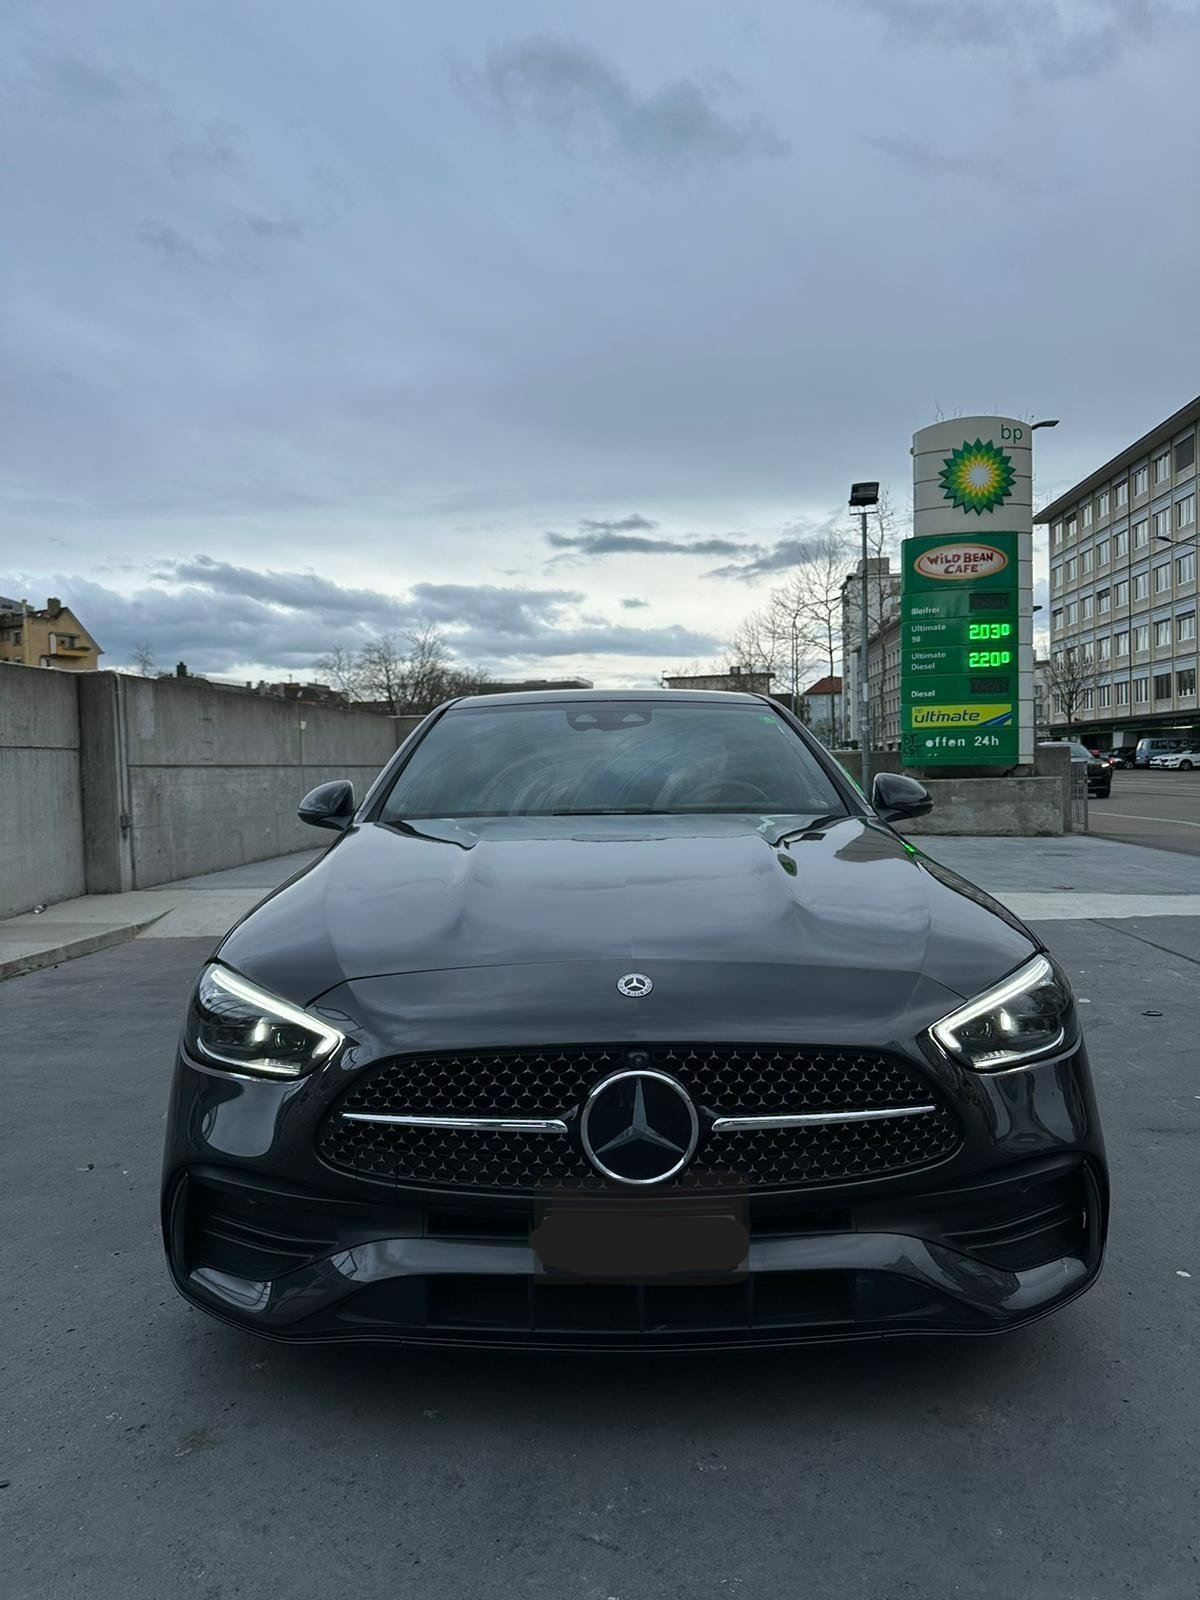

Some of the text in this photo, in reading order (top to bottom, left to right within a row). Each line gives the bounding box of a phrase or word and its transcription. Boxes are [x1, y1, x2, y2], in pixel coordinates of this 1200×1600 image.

[1001, 424, 1023, 444] bp
[964, 552, 994, 563] BEAN
[943, 564, 979, 574] CAFE
[911, 606, 940, 615] Bleifrei
[911, 624, 946, 632] Ultimate
[911, 652, 946, 660] Ultimate
[911, 662, 935, 671] Diesel
[911, 690, 935, 698] Diesel
[914, 710, 980, 723] ultimate
[925, 735, 999, 747] offen 24h
